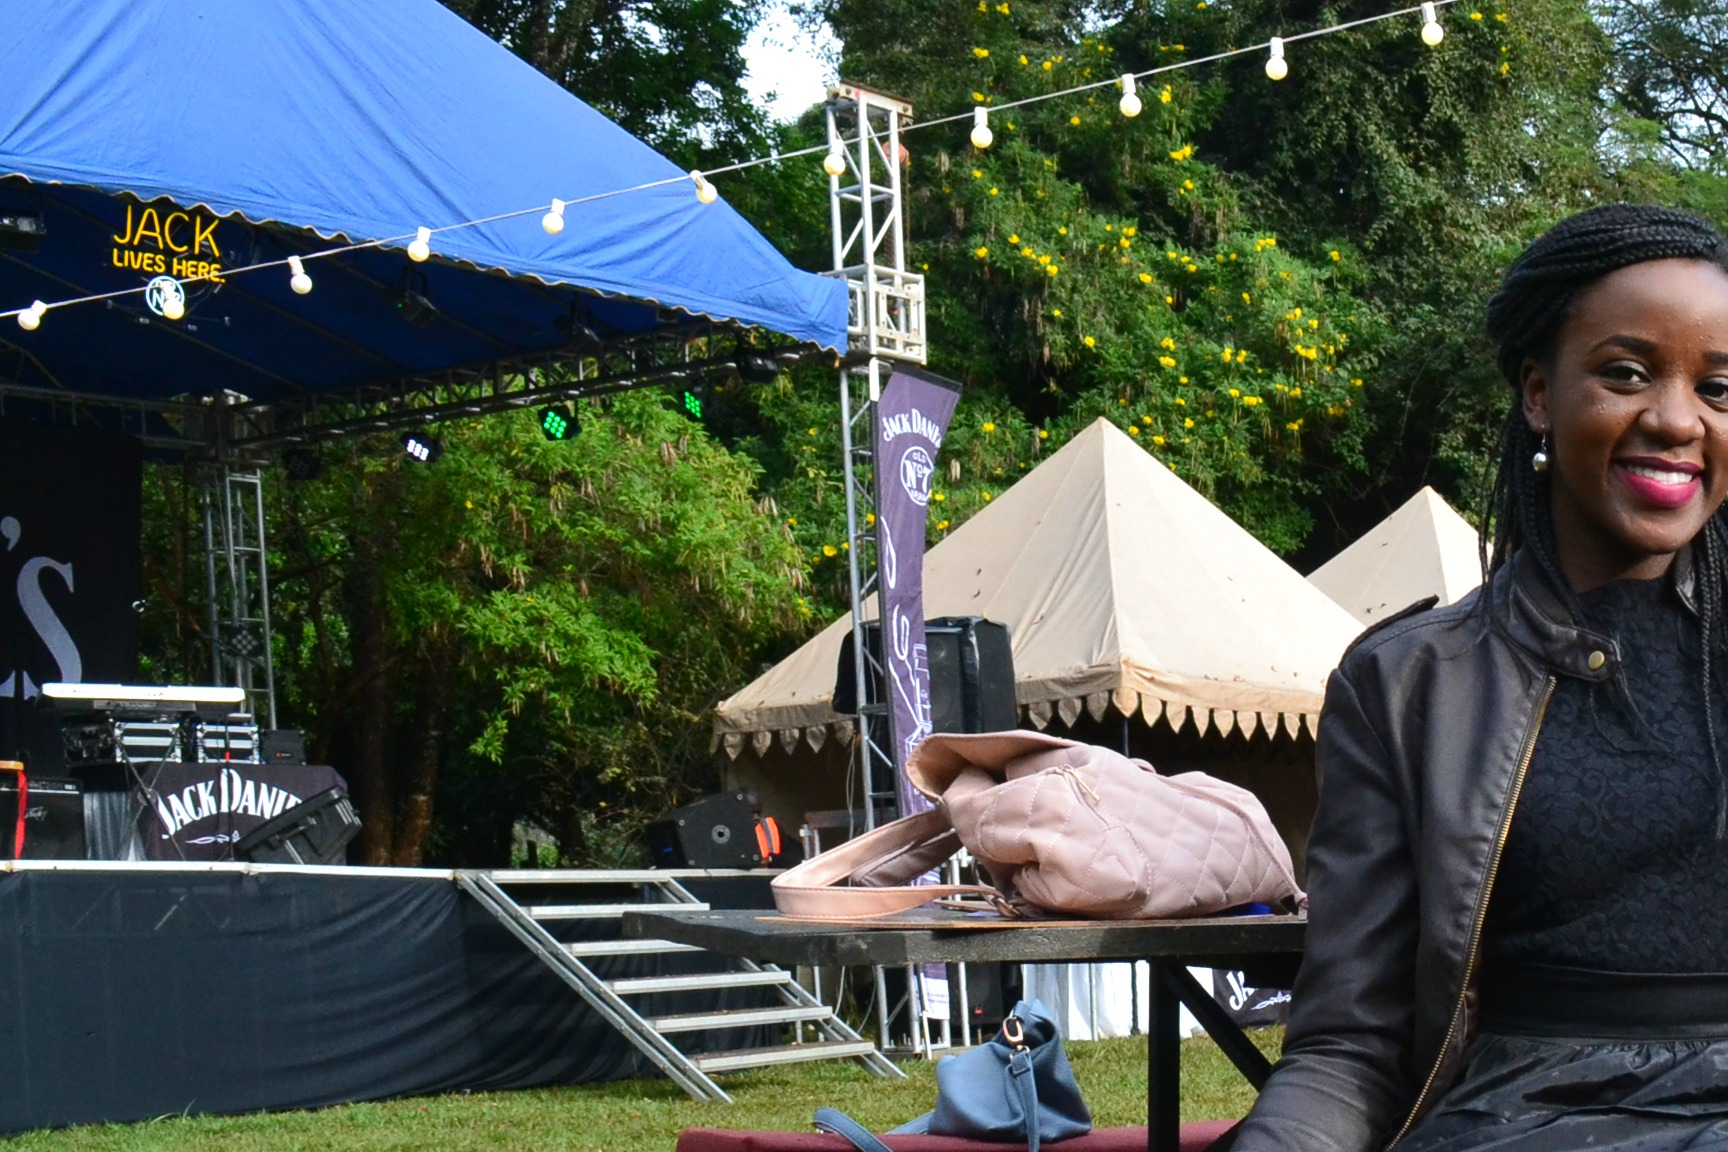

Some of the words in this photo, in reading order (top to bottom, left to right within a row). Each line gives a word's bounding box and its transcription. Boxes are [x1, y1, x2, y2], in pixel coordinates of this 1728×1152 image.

[114, 205, 219, 257] JACK
[113, 248, 166, 273] LIVES
[882, 413, 912, 442] JACK
[157, 779, 217, 840] JACK
